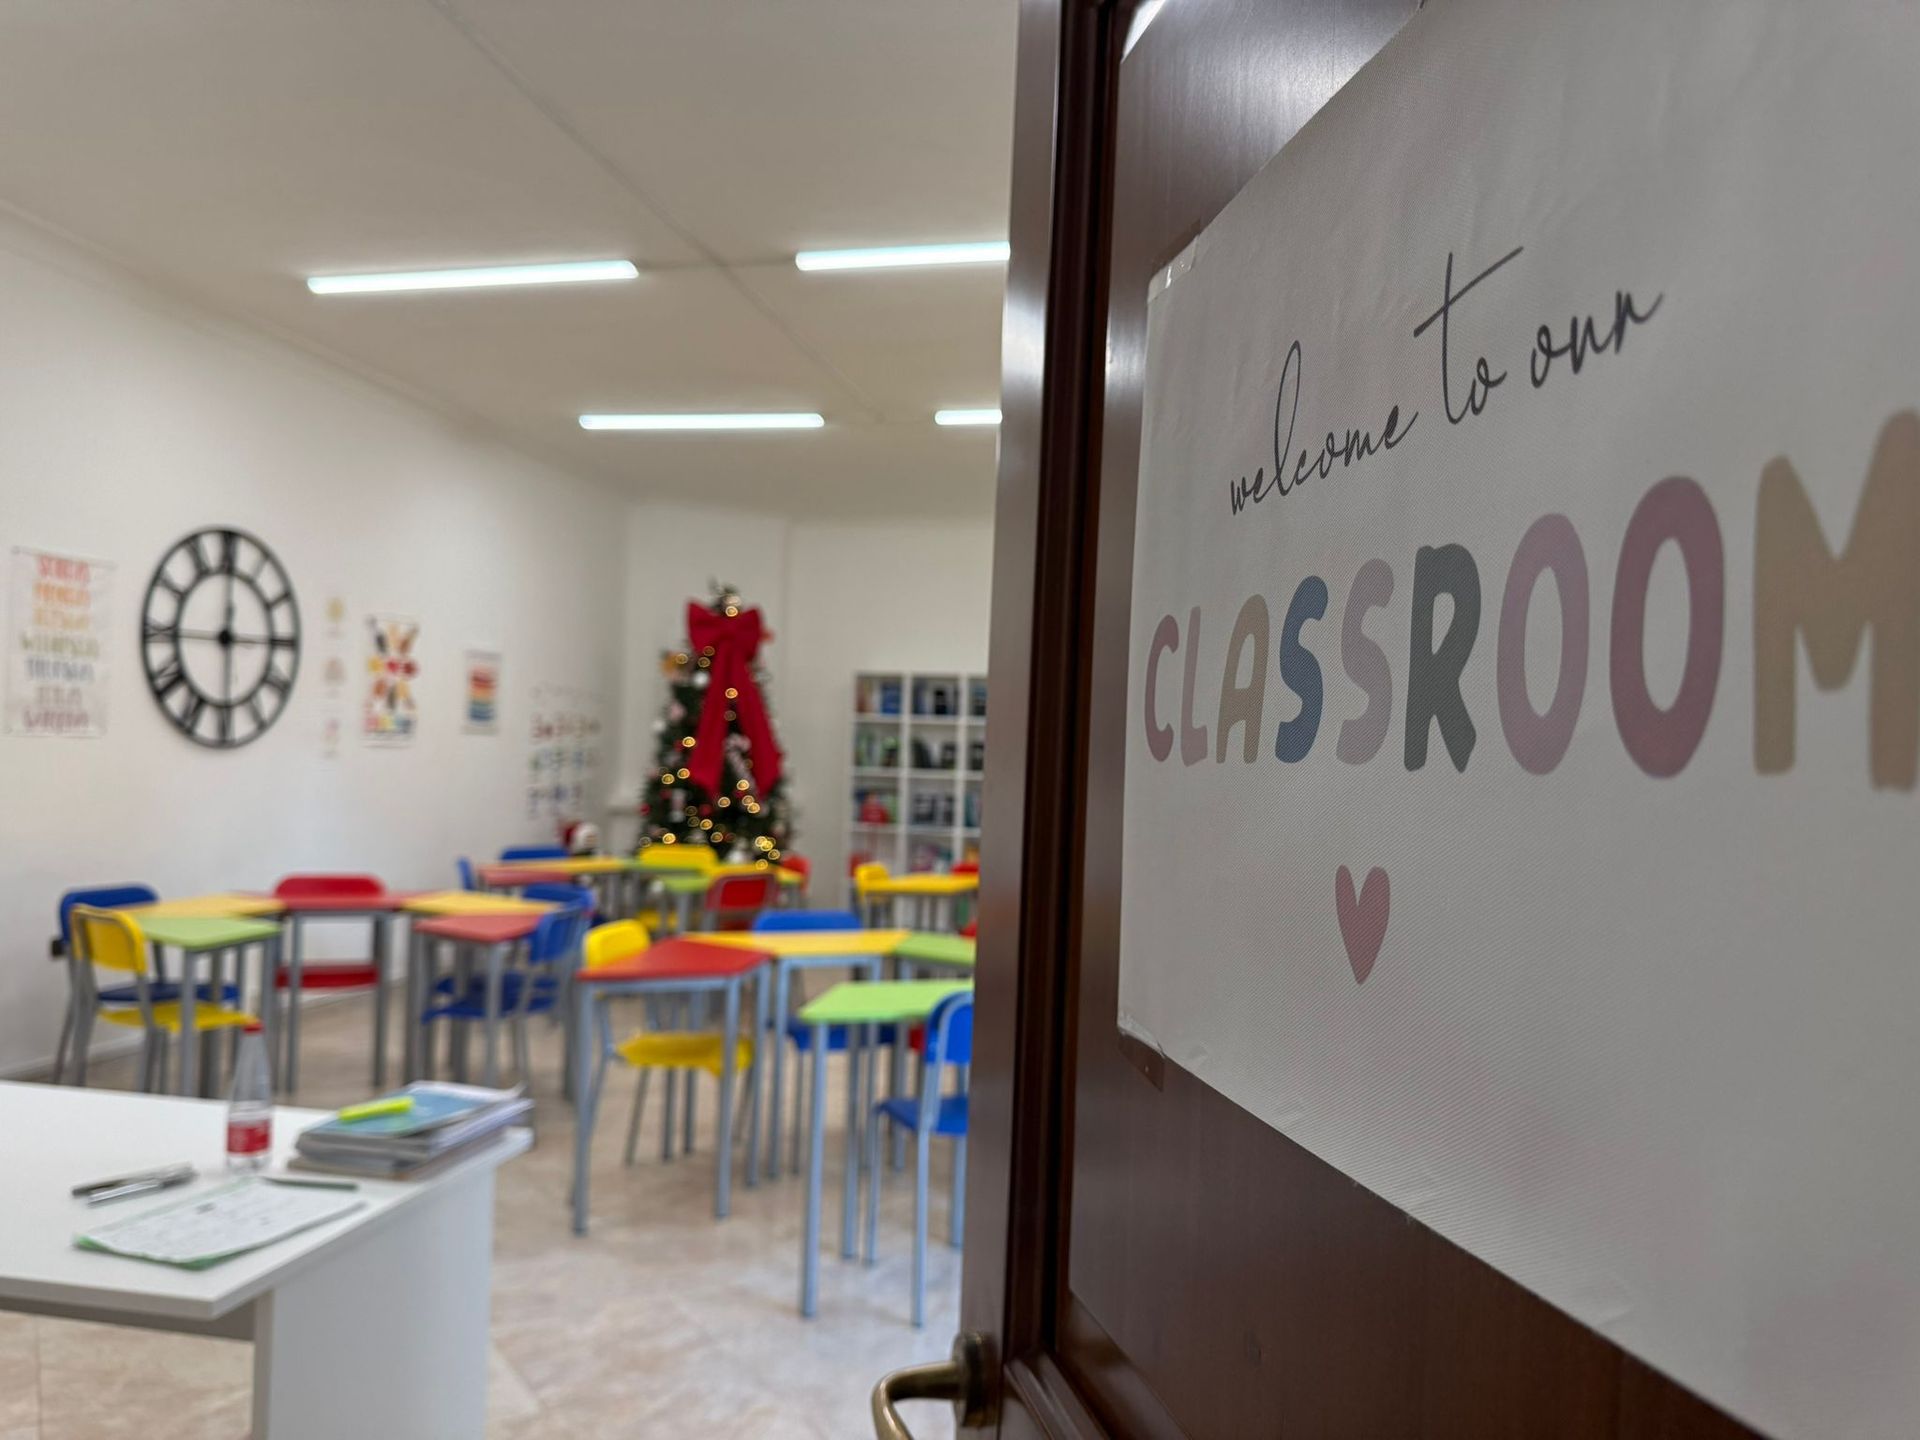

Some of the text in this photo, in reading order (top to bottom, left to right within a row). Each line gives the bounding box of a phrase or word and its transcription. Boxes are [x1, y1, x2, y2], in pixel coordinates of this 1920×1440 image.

[1231, 246, 1664, 516] welcome to our
[1143, 408, 1920, 792] CLASSROOM
